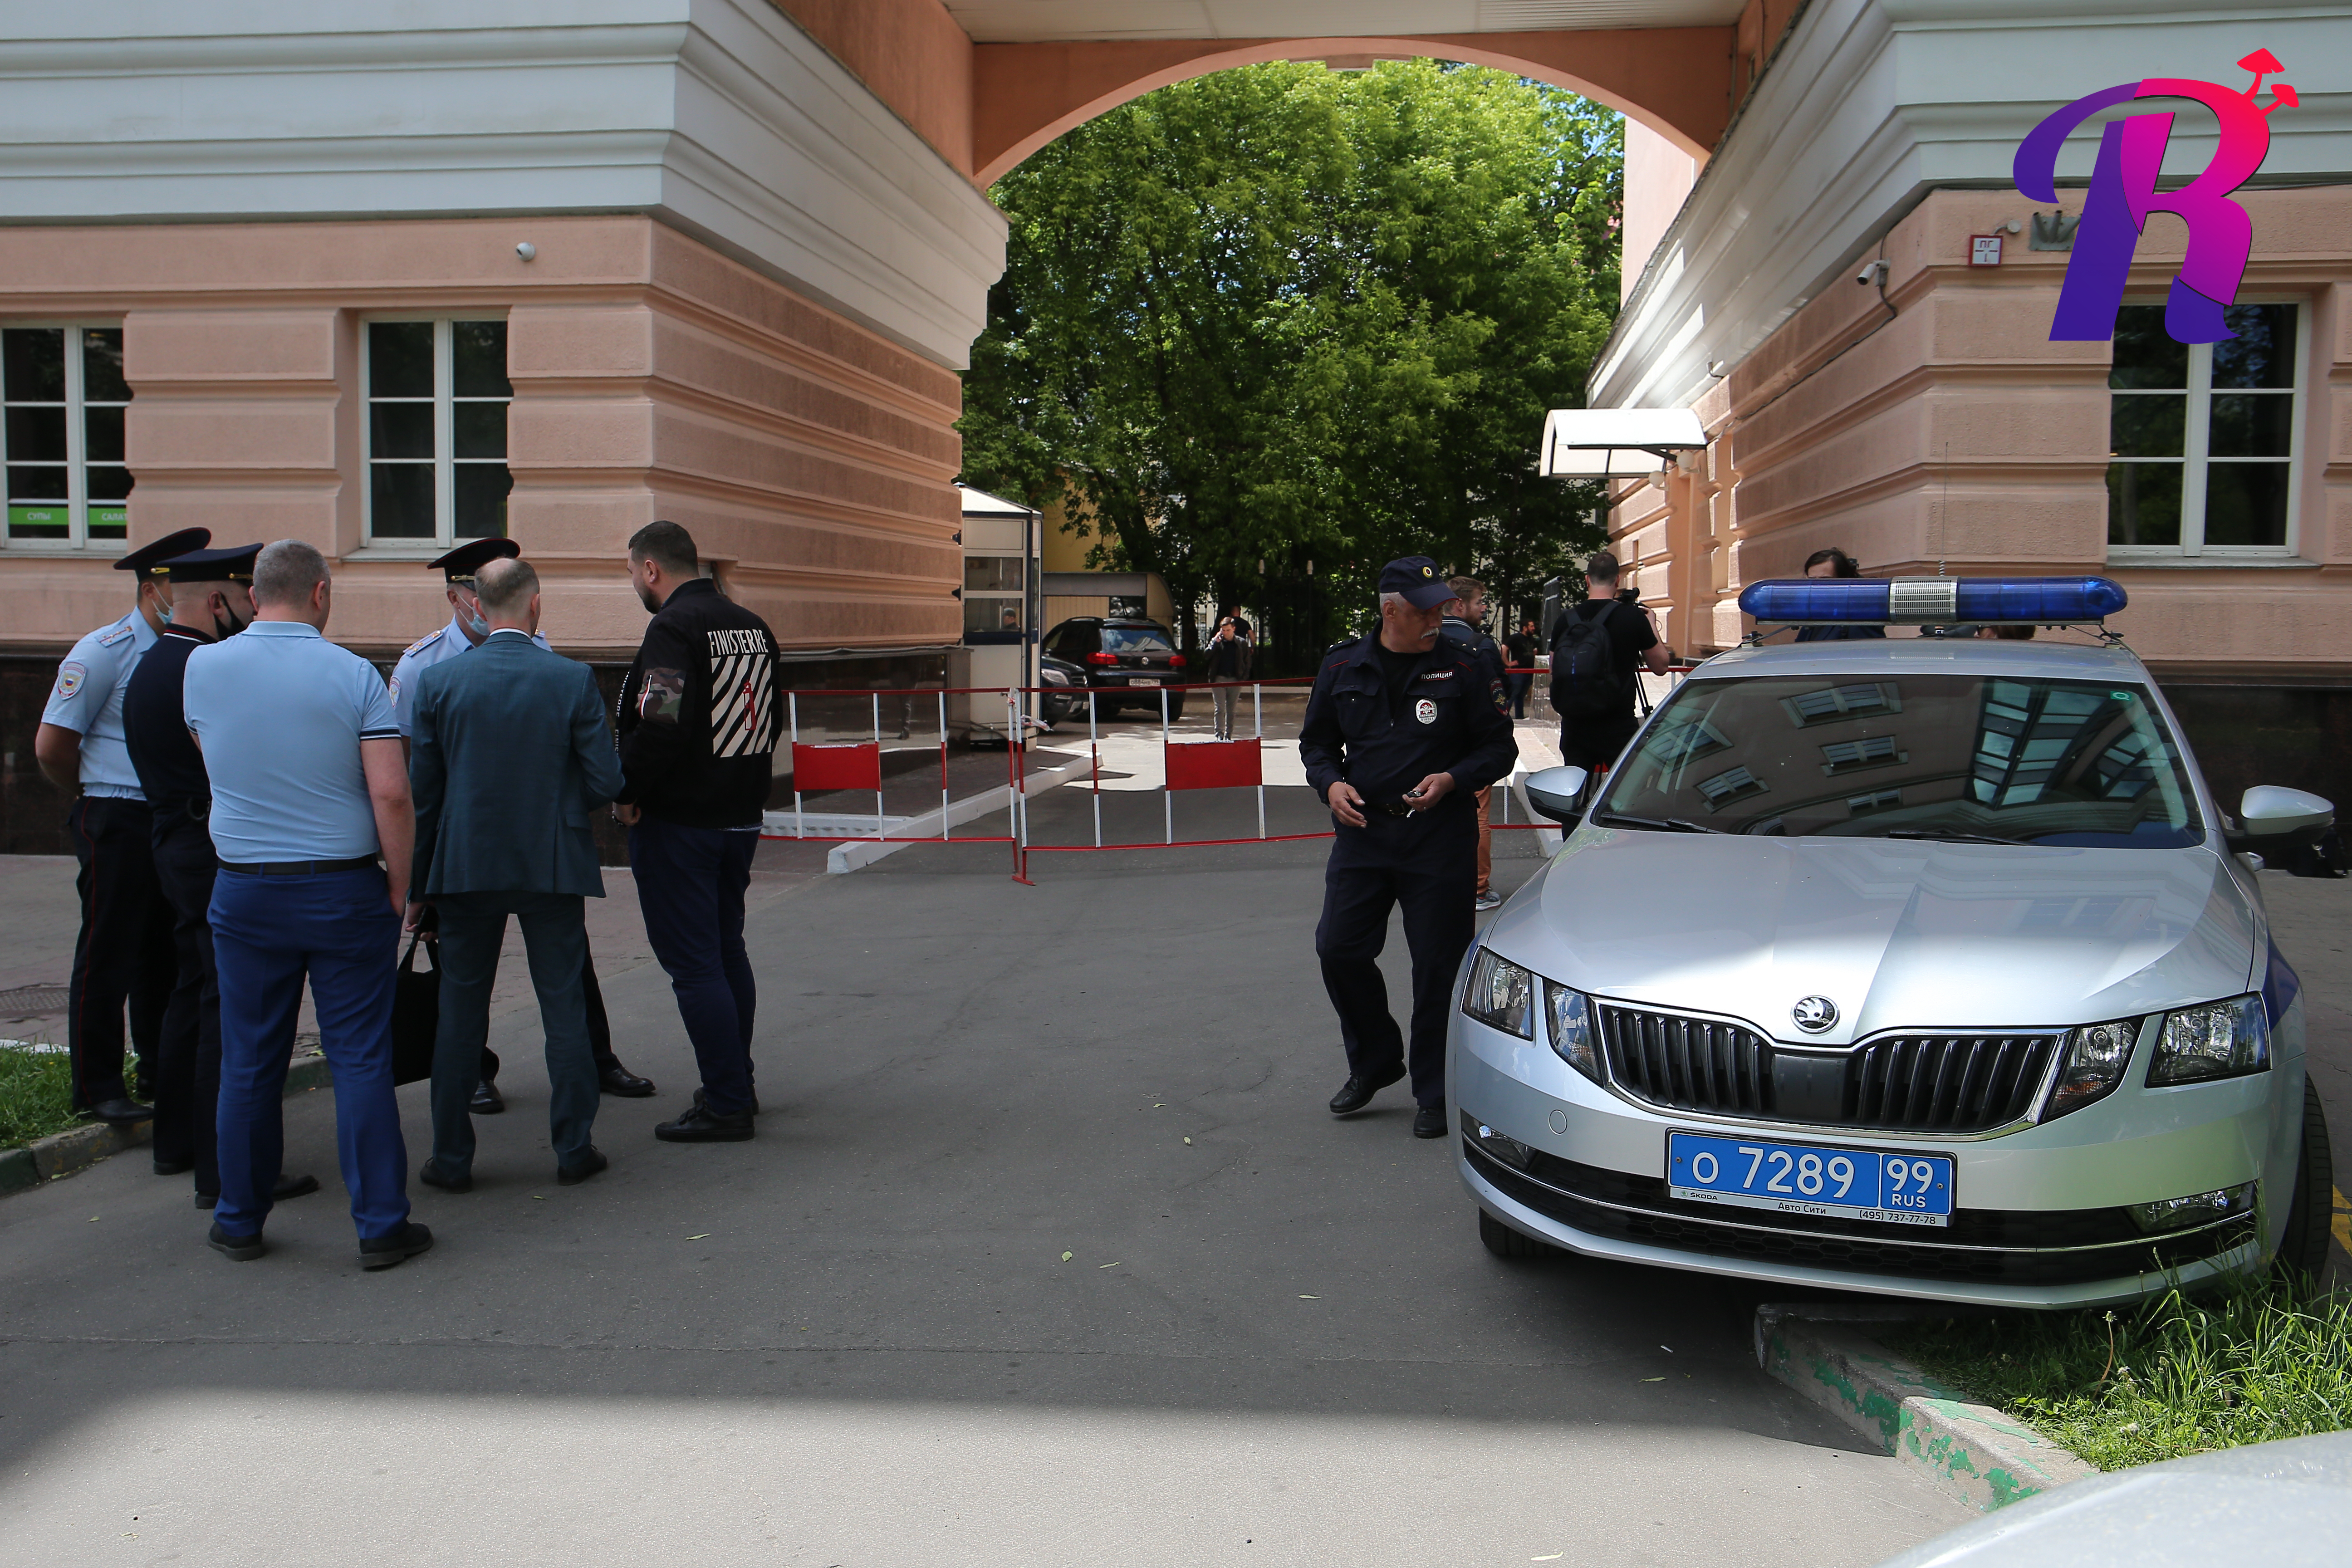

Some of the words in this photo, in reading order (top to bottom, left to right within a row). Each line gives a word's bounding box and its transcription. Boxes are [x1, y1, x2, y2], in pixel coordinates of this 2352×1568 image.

[27, 512, 51, 520] СУПЫ
[707, 629, 769, 656] FINISTERRE
[1738, 1146, 1855, 1198] 7289
[1886, 1159, 1933, 1193] 99
[1892, 1194, 1926, 1208] RUS
[1778, 1202, 1800, 1211] Авто
[1803, 1205, 1826, 1215] Сити
[1860, 1210, 1883, 1220] (495)
[1888, 1213, 1936, 1225] 737-77-78
